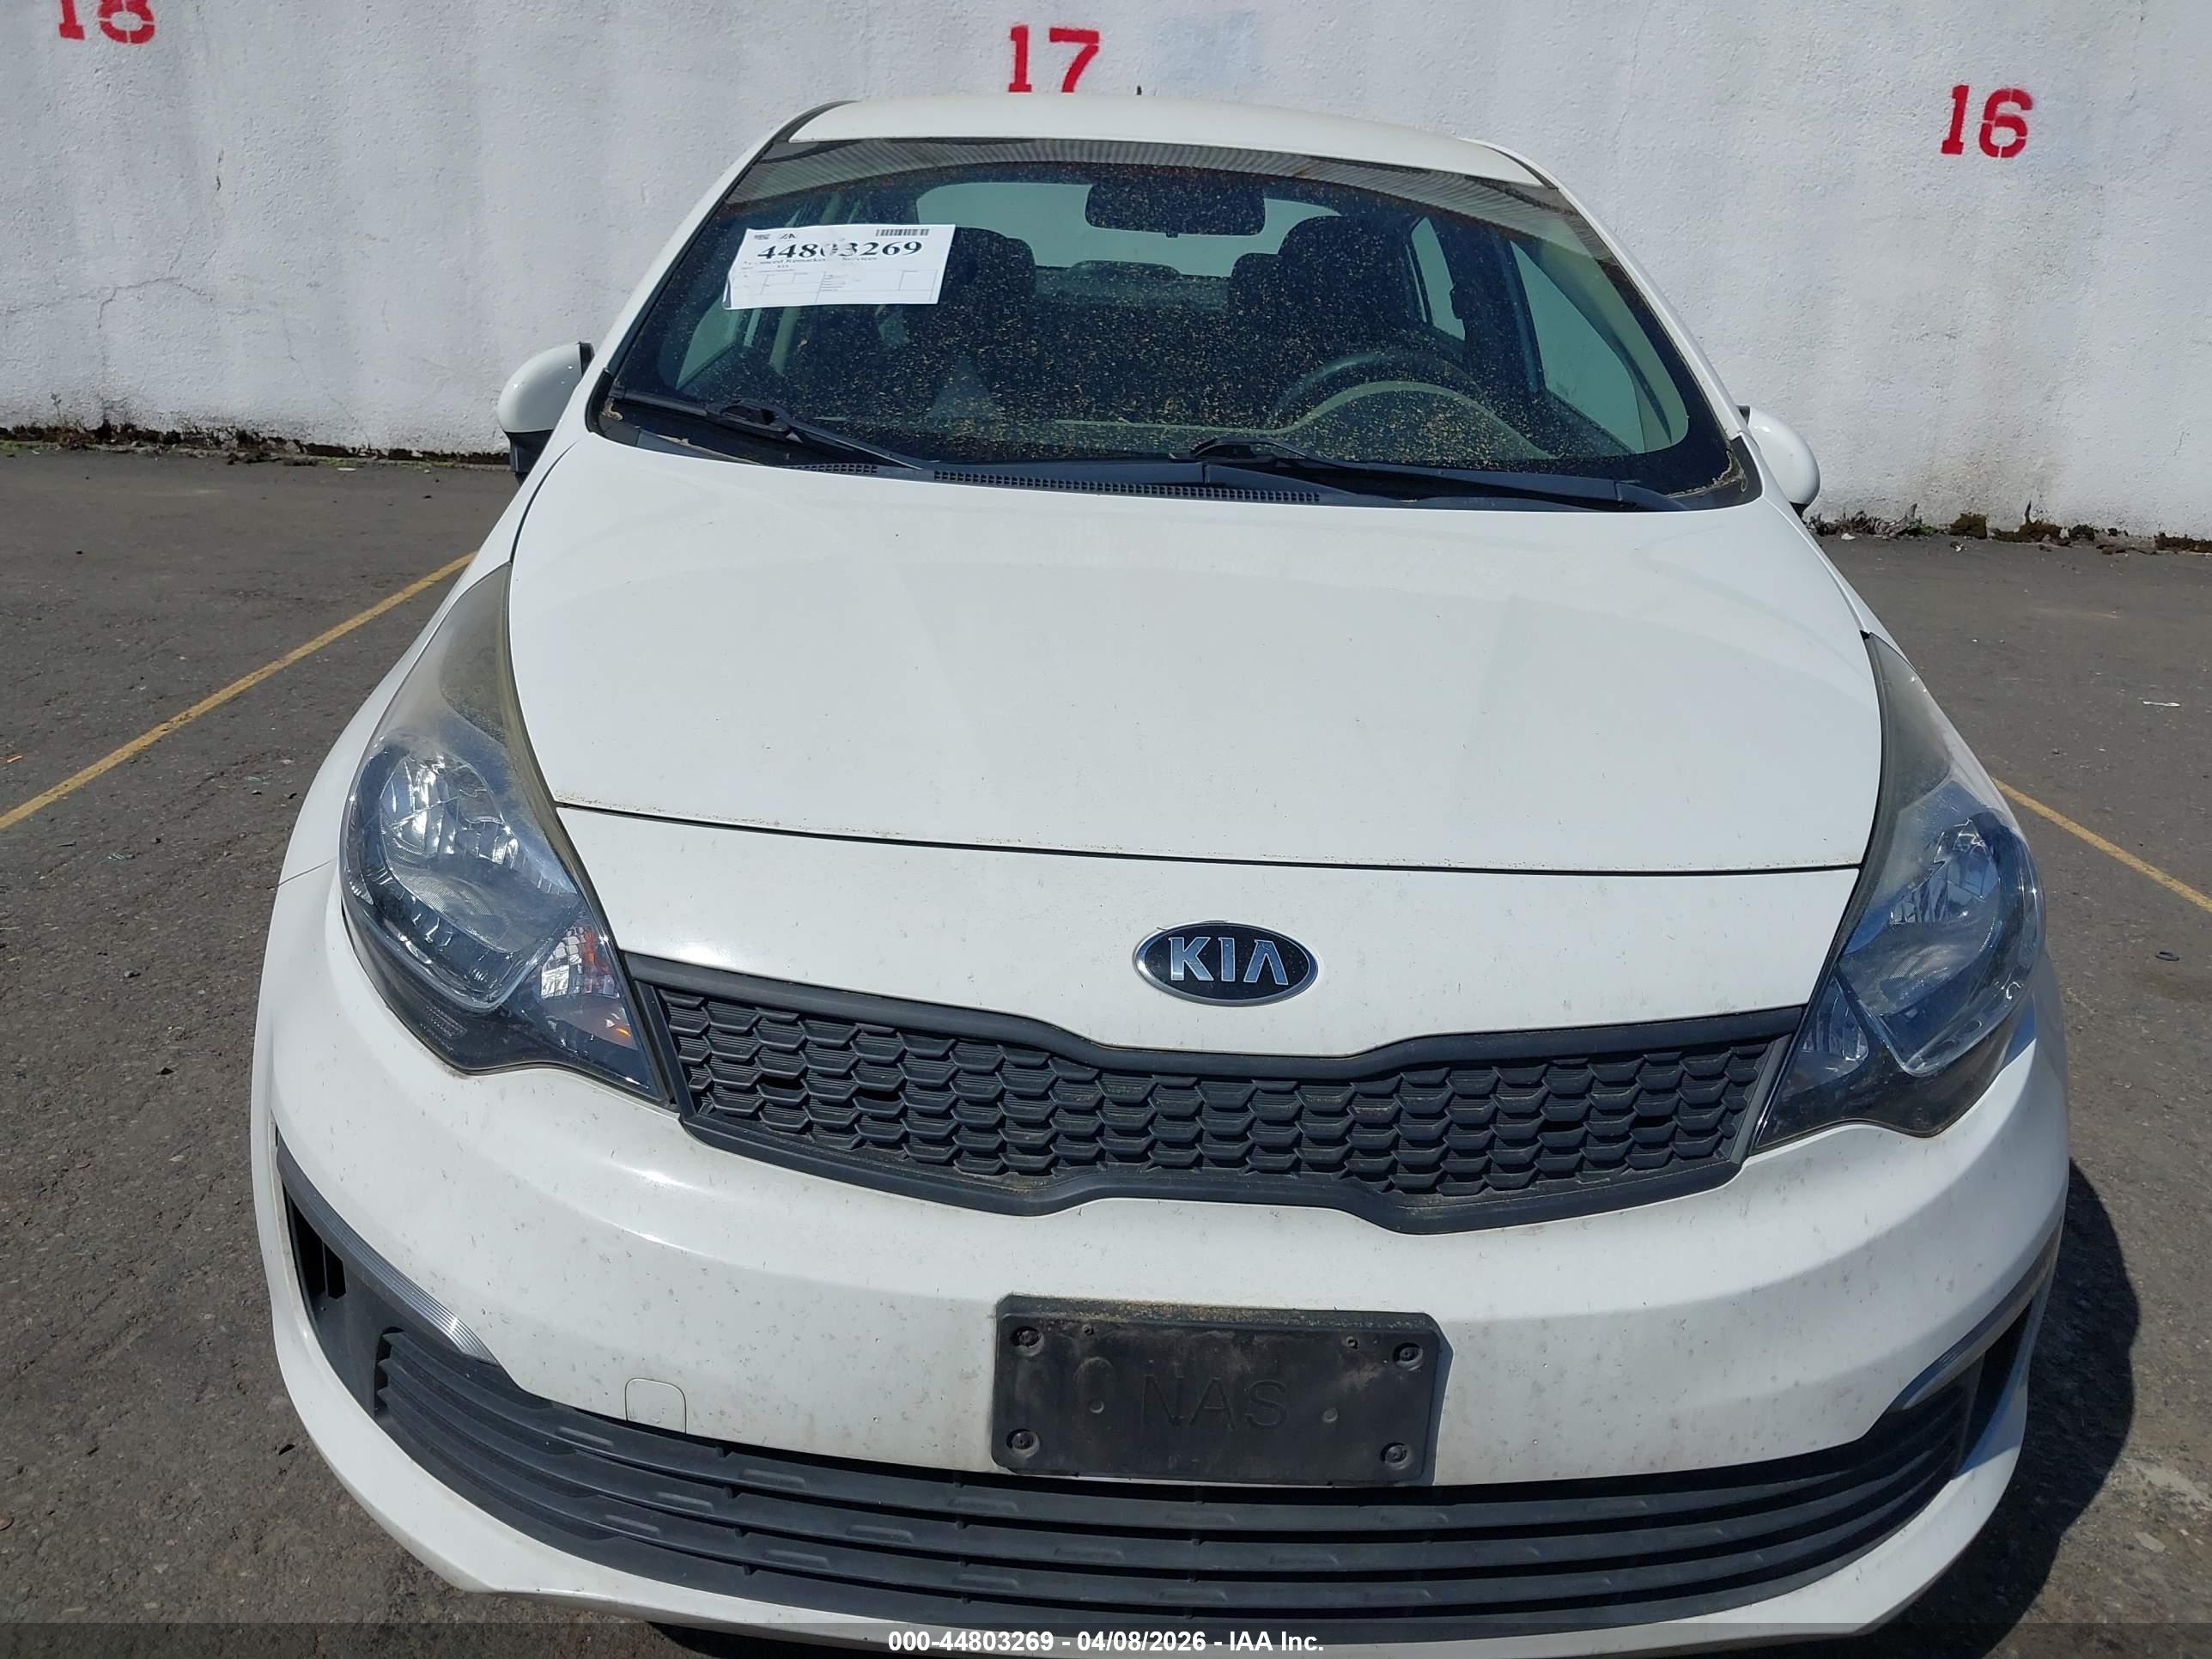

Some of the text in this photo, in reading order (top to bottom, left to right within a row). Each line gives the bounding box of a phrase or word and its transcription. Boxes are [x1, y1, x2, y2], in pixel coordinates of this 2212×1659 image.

[58, 0, 156, 44] 18
[1007, 24, 1100, 93] 17
[1940, 84, 2034, 158] 16
[1168, 936, 1289, 986] KIA
[1140, 1373, 1289, 1432] NAS
